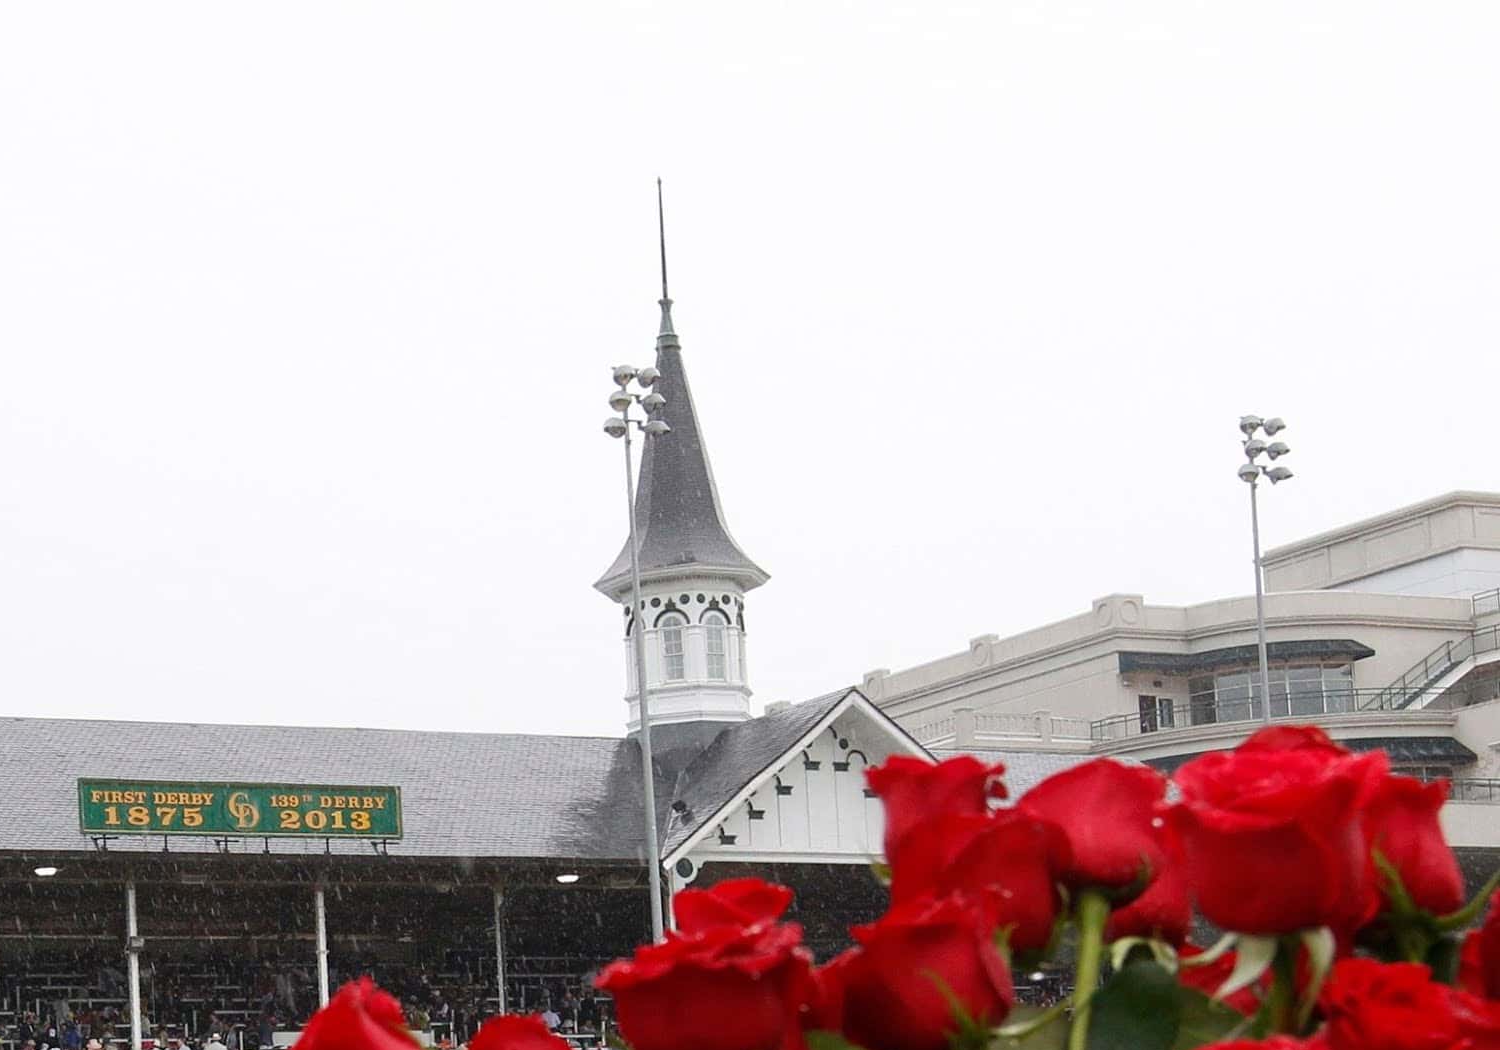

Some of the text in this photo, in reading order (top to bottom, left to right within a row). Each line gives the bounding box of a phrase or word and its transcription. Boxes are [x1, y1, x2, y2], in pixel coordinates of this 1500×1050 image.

[91, 790, 213, 806] FIRST DERBY
[319, 795, 386, 809] DERBY
[104, 806, 204, 827] 1875
[280, 810, 372, 830] 2013
